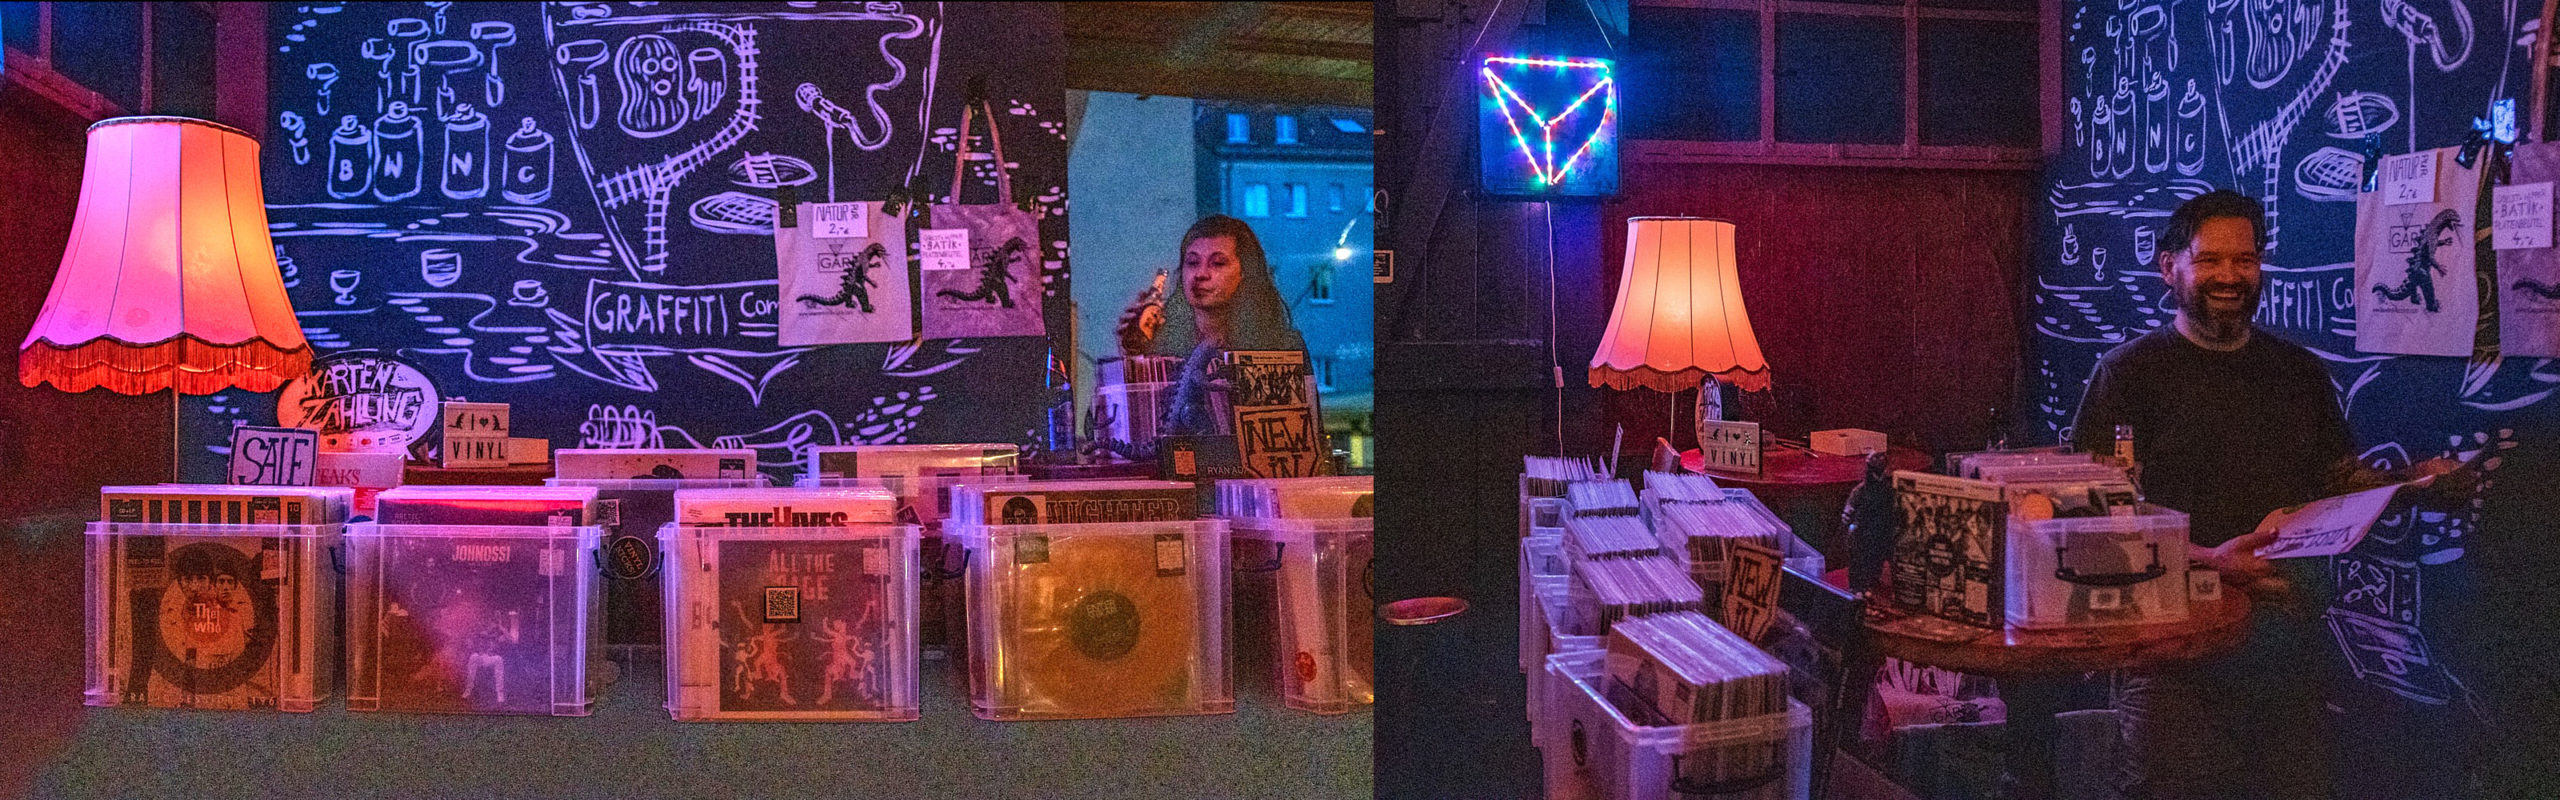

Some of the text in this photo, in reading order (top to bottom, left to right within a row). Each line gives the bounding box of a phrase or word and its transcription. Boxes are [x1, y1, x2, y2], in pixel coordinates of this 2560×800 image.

[2095, 139, 2103, 161] B
[2150, 122, 2161, 149] N
[2184, 133, 2196, 152] C
[338, 159, 354, 182] B
[451, 151, 473, 177] N
[517, 165, 536, 183] C
[2388, 155, 2421, 183] NATUR
[815, 204, 849, 222] NATUR
[591, 291, 729, 338] GRAFFITI
[2254, 276, 2355, 334] AFFITI Co
[303, 358, 398, 399] KARTEN
[299, 387, 422, 432] ZAHLUNG
[471, 413, 475, 431] I
[1243, 412, 1312, 456] NEW
[237, 436, 310, 486] SALE
[452, 441, 505, 460] VINYL
[1710, 449, 1756, 467] VINYL
[316, 468, 361, 486] EAKS
[1207, 465, 1230, 475] RYAN
[1266, 453, 1304, 478] IN
[724, 511, 773, 528] THE
[773, 505, 850, 528] HIVES
[1045, 497, 1180, 523] AUGHTER
[451, 544, 511, 563] JOHNOSSI
[622, 540, 644, 570] VINYL
[769, 549, 836, 573] ALL THE
[1728, 554, 1780, 609] NEW
[192, 603, 217, 620] The
